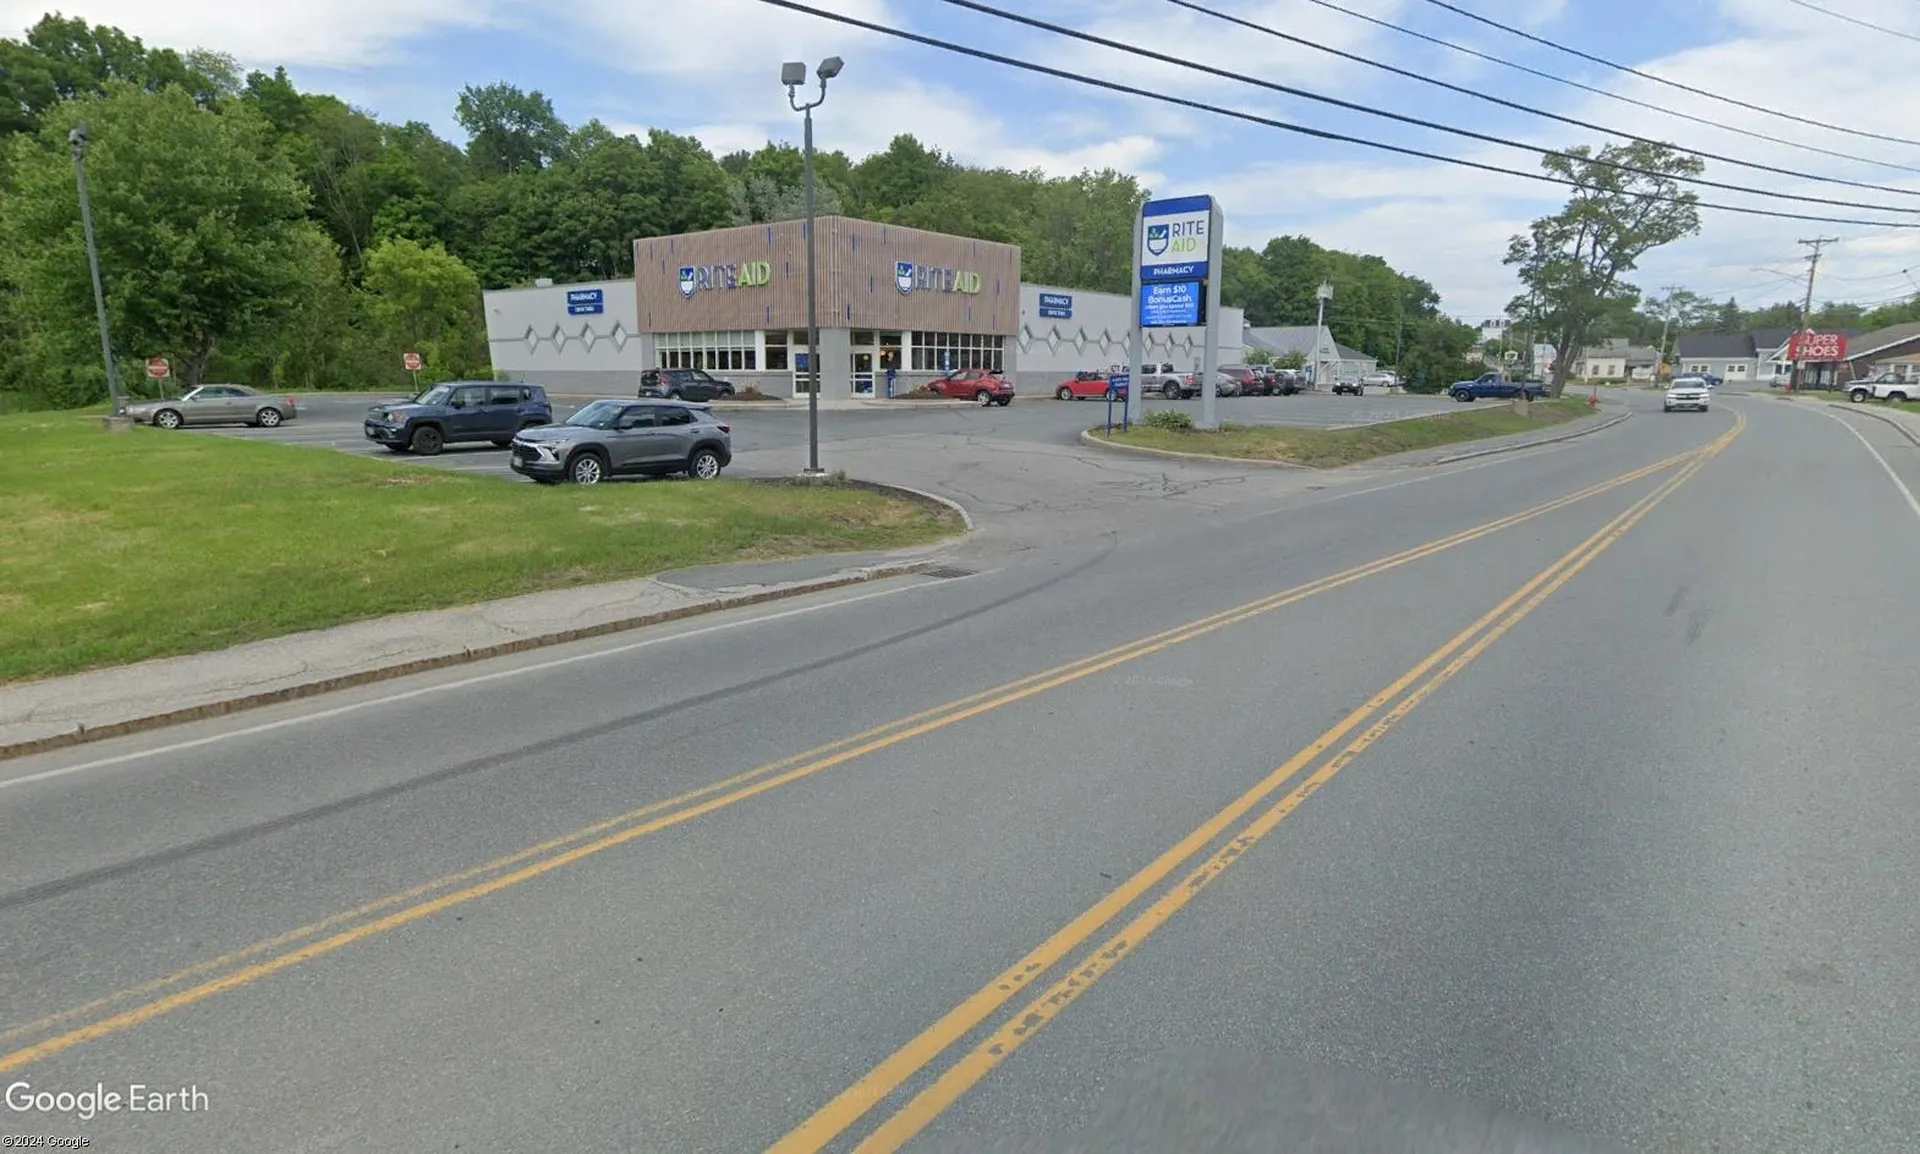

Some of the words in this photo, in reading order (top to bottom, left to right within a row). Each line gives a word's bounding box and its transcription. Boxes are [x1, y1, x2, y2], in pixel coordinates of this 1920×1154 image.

[1172, 220, 1204, 237] RITE
[1171, 237, 1197, 252] AID
[697, 263, 736, 291] RITE
[738, 260, 771, 288] AID
[1153, 265, 1195, 276] PHARMACY
[952, 270, 982, 295] AID
[1153, 286, 1172, 295] Earn
[1173, 285, 1187, 294] $10
